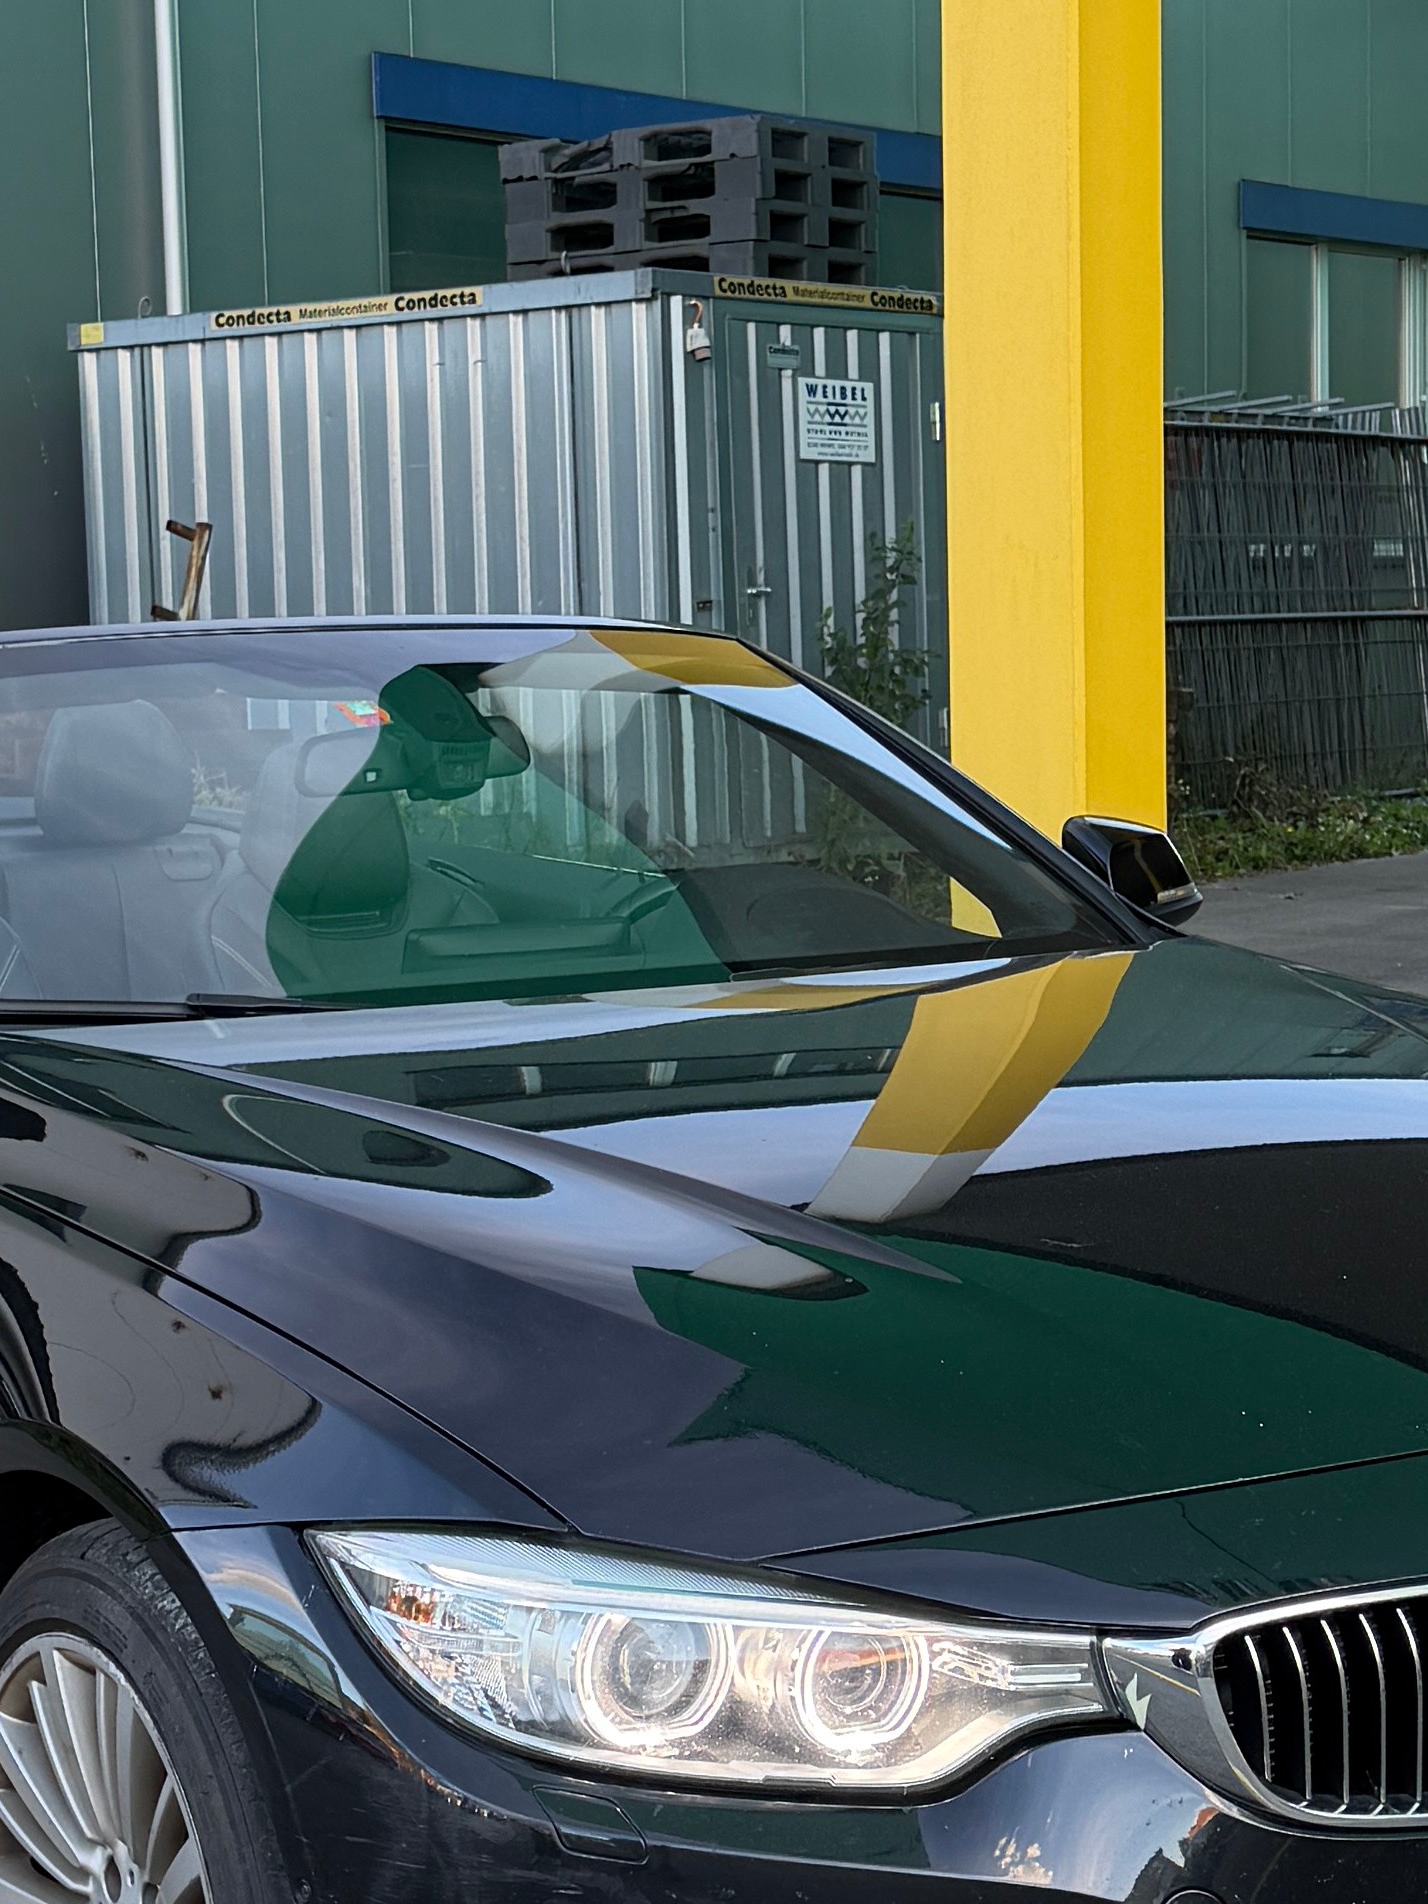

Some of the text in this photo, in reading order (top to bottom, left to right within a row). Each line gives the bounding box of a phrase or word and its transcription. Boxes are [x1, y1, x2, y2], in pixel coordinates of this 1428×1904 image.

[214, 290, 478, 328] Condecta Materialcontainer Condecta
[718, 277, 787, 298] Condecta
[870, 291, 935, 312] Condecta
[805, 383, 867, 402] WEIBEL
